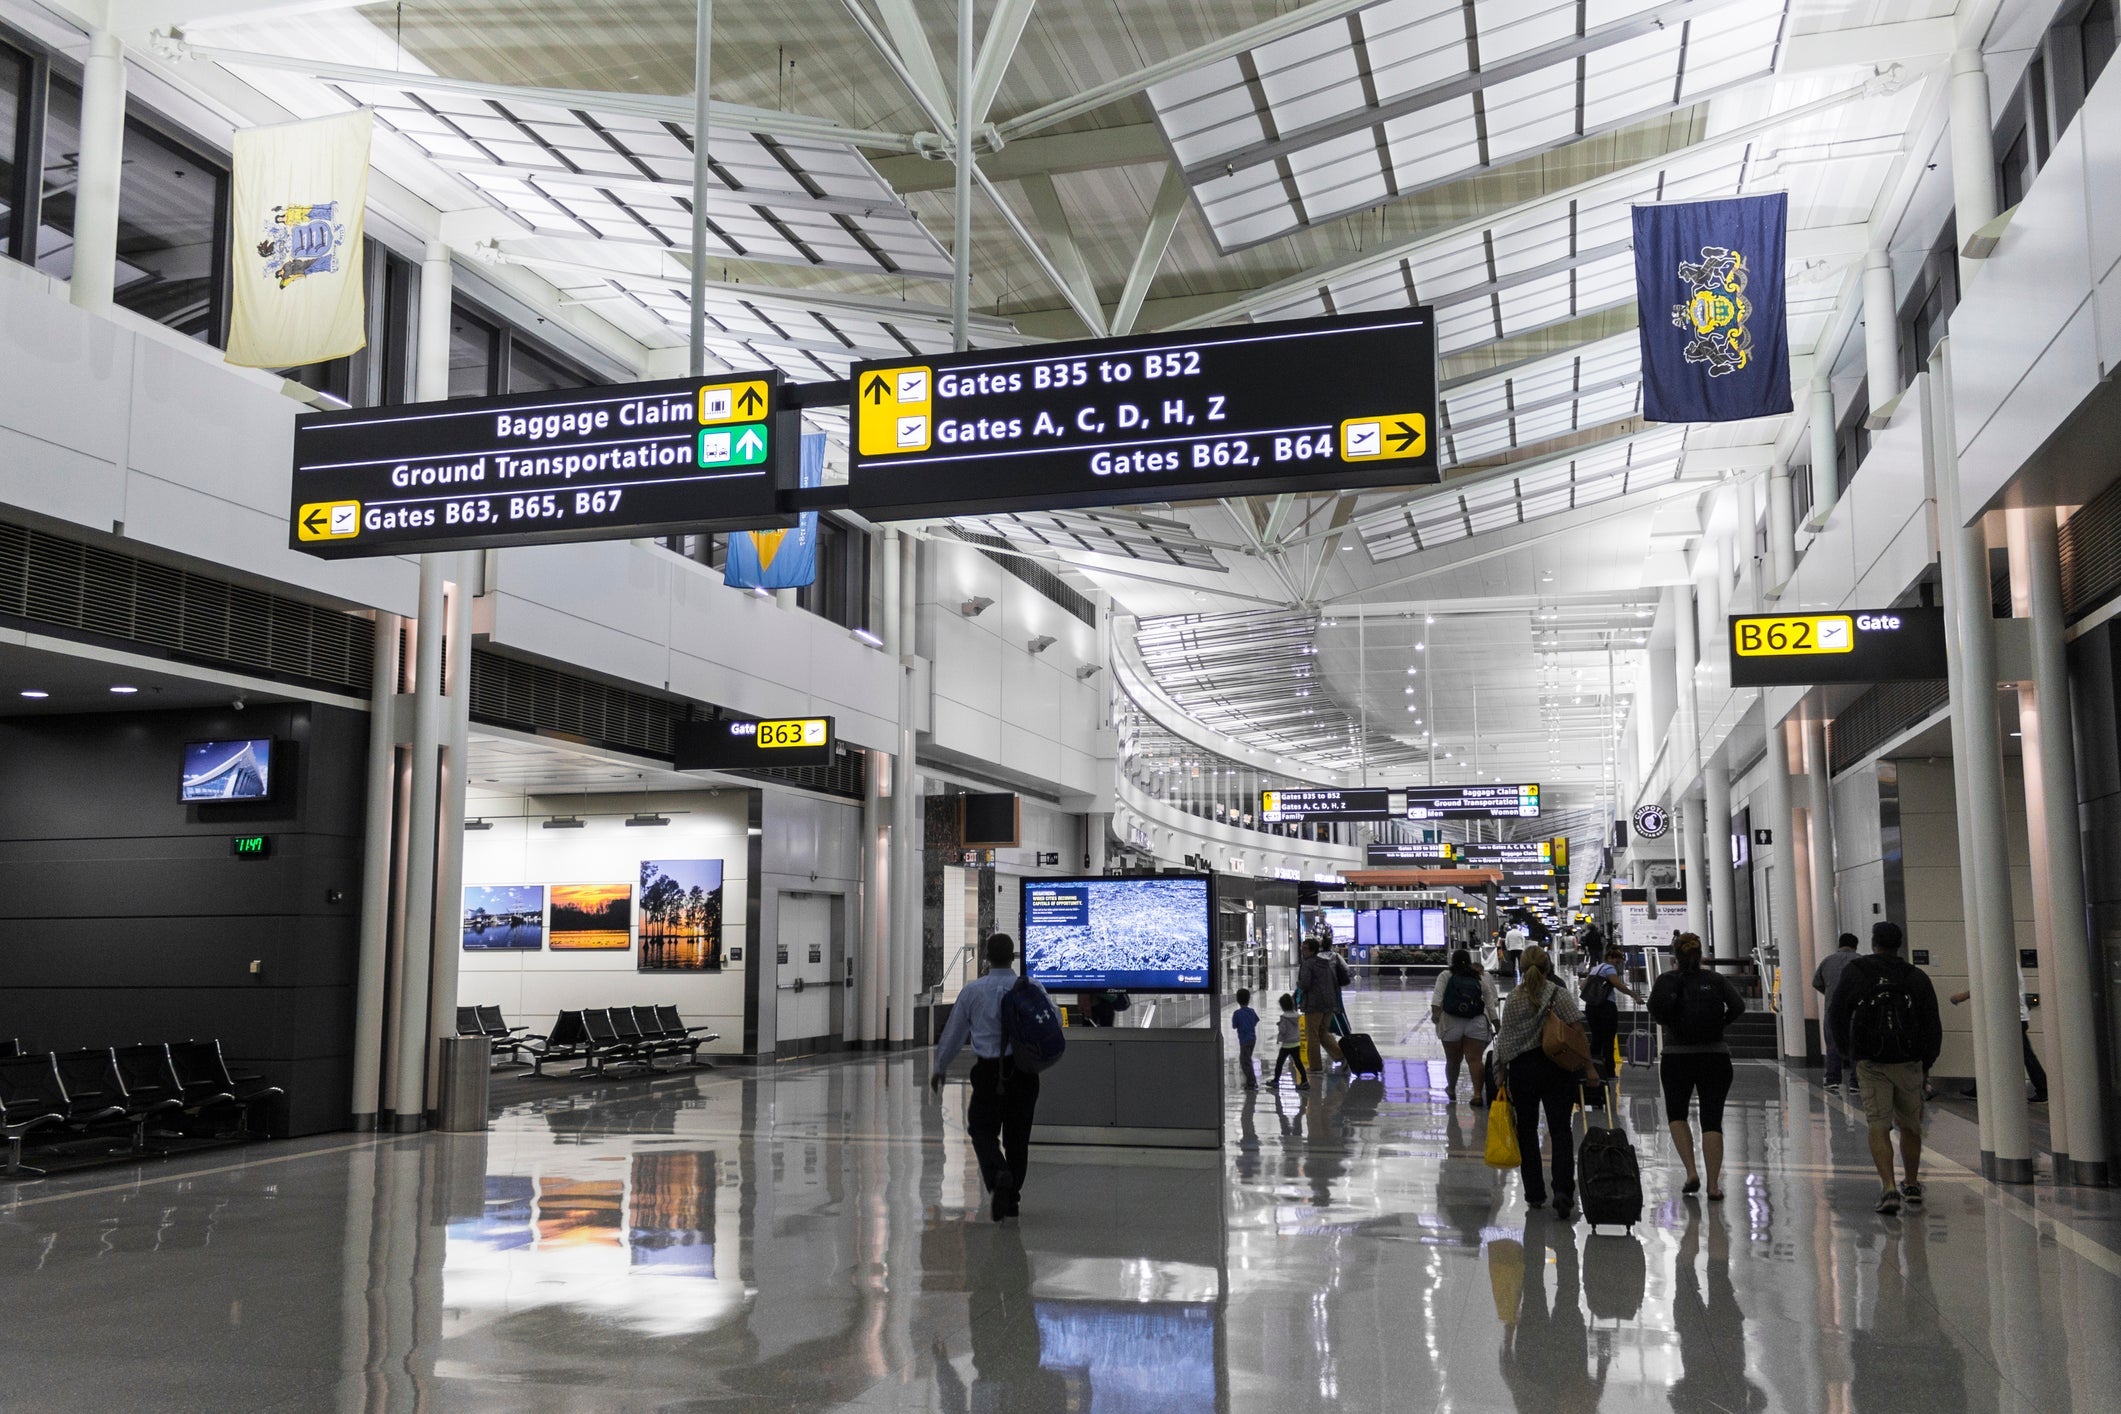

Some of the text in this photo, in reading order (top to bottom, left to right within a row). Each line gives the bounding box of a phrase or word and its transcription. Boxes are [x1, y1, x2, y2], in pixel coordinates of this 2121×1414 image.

[938, 351, 1200, 398] Gates B35 to B52
[497, 400, 693, 440] Baggage Claim
[937, 395, 1226, 444] Gates A, C, D, H, Z
[391, 442, 692, 487] Ground Transportation
[1090, 434, 1334, 476] Gates B62, B64
[364, 490, 622, 531] Gates B63, B65, B67
[1741, 622, 1812, 650] B62
[1856, 615, 1900, 630] Gate
[731, 723, 756, 735] Gate
[760, 724, 802, 744] B63
[1463, 789, 1495, 797] Baggage
[1464, 798, 1518, 807] Transportation
[1634, 805, 1668, 820] CHIPOTLE
